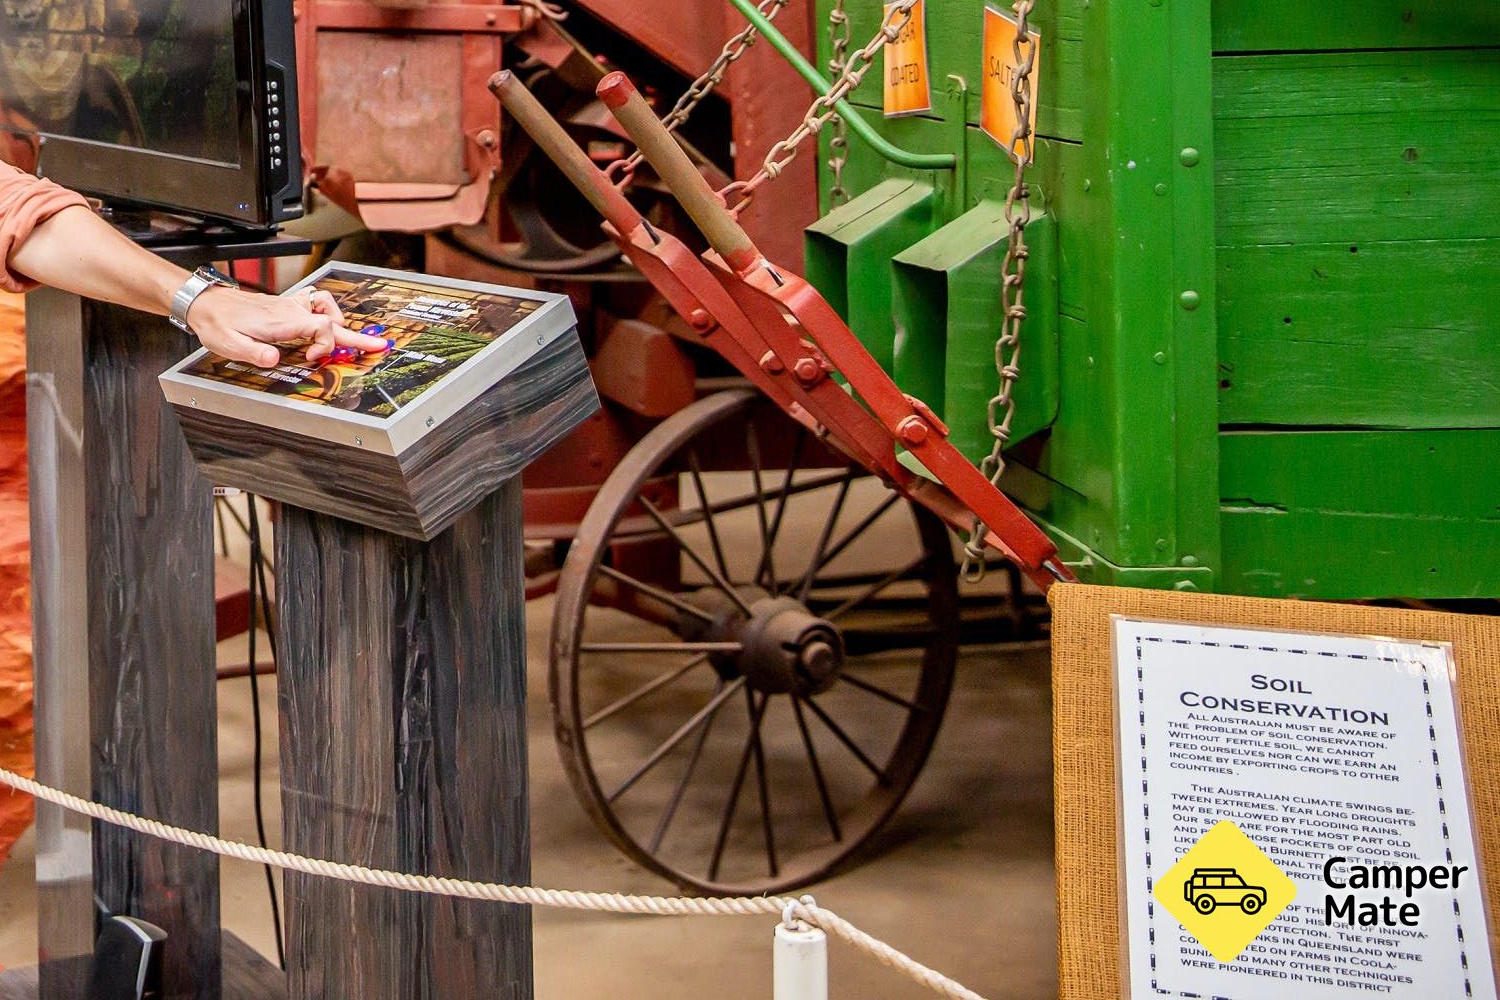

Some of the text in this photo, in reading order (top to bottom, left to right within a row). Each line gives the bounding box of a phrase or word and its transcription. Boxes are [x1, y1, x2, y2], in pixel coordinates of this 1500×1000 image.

[1250, 675, 1313, 694] SOIL
[1179, 692, 1389, 725] CONSERVATION
[1187, 713, 1210, 721] ALL
[1211, 715, 1283, 728] AUSTRALIAN
[1285, 723, 1316, 731] MUST
[1336, 728, 1379, 738] AWARE
[1194, 724, 1248, 735] PROBLEM
[1267, 732, 1294, 740] SOIL
[1295, 735, 1388, 749] CONSERVATION.
[1167, 731, 1221, 742] WITHOUT
[1225, 737, 1272, 747] FERTILE
[1304, 745, 1324, 753] WE
[1326, 747, 1375, 758] CANNOT
[1168, 742, 1198, 750] FEED
[1199, 745, 1266, 757] OURSELVES
[1267, 752, 1293, 760] NOR
[1294, 755, 1320, 763] CAN
[1343, 760, 1377, 769] EARN
[1169, 752, 1213, 762] INCOME
[1232, 759, 1298, 771] EXPORTING
[1299, 765, 1340, 775] CROPS
[1359, 771, 1400, 782] OTHER
[1169, 762, 1234, 775] COUNTRIES
[1170, 793, 1417, 826] TWEEN EXTREMES. YEAR LONG DROUGHTS
[1190, 784, 1215, 793] THE
[1216, 787, 1290, 801] AUSTRALIAN
[1292, 796, 1343, 807] CLIMATE
[1345, 802, 1393, 813] SWINGS
[1172, 804, 1195, 812] MAY
[1215, 809, 1279, 822] FOLLOWED
[1298, 819, 1359, 831] FLOODING
[1361, 826, 1402, 836] RAINS.
[1172, 814, 1199, 823] OUR
[1239, 822, 1263, 830] ARE
[1264, 825, 1289, 833] FOR
[1290, 828, 1315, 836] THE
[1317, 831, 1350, 840] MOST
[1352, 835, 1384, 844] PART
[1386, 838, 1411, 847] OLD
[1173, 826, 1198, 834] AND
[1280, 838, 1335, 849] POCKETS
[1355, 846, 1391, 856] GOOD
[1393, 850, 1421, 859] SOIL
[1269, 846, 1326, 859] BURNETT
[1364, 858, 1380, 867] BE
[1337, 932, 1363, 943] THE
[1365, 937, 1401, 947] FIRST
[1378, 927, 1429, 939] INNOVA-
[1269, 947, 1287, 956] ON
[1290, 950, 1332, 961] FARMS
[1349, 957, 1398, 969] COOLA-
[1282, 937, 1295, 945] IN
[1297, 939, 1383, 956] QUEENSLAND
[1385, 950, 1423, 962] WERE
[1180, 959, 1393, 993] WERE PIONEERED IN THIS DISTRICT
[1251, 957, 1287, 967] MANY
[1289, 962, 1331, 973] OTHER
[1332, 967, 1414, 984] TECHNIQUES
